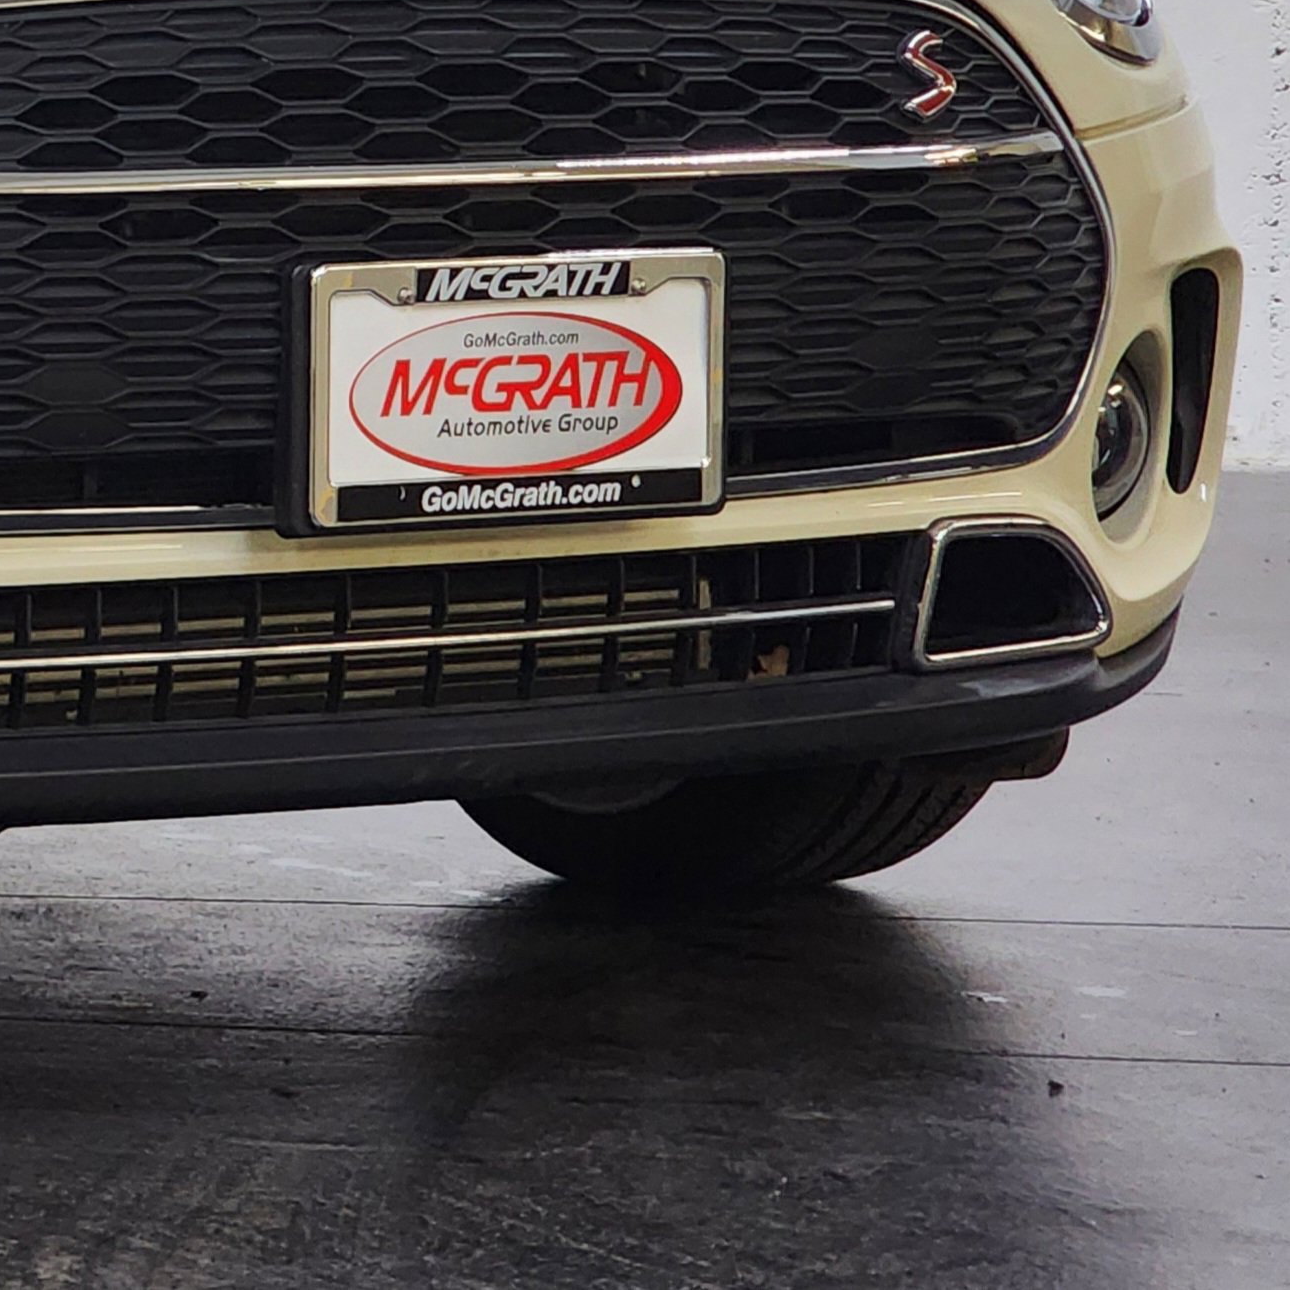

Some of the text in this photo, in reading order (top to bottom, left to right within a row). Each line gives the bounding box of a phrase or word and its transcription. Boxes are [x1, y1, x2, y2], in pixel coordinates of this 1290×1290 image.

[903, 29, 957, 117] S
[463, 330, 579, 349] GoMcGrath.com
[436, 414, 619, 439] Automotive Group
[421, 481, 621, 513] GoMcGrath.com
